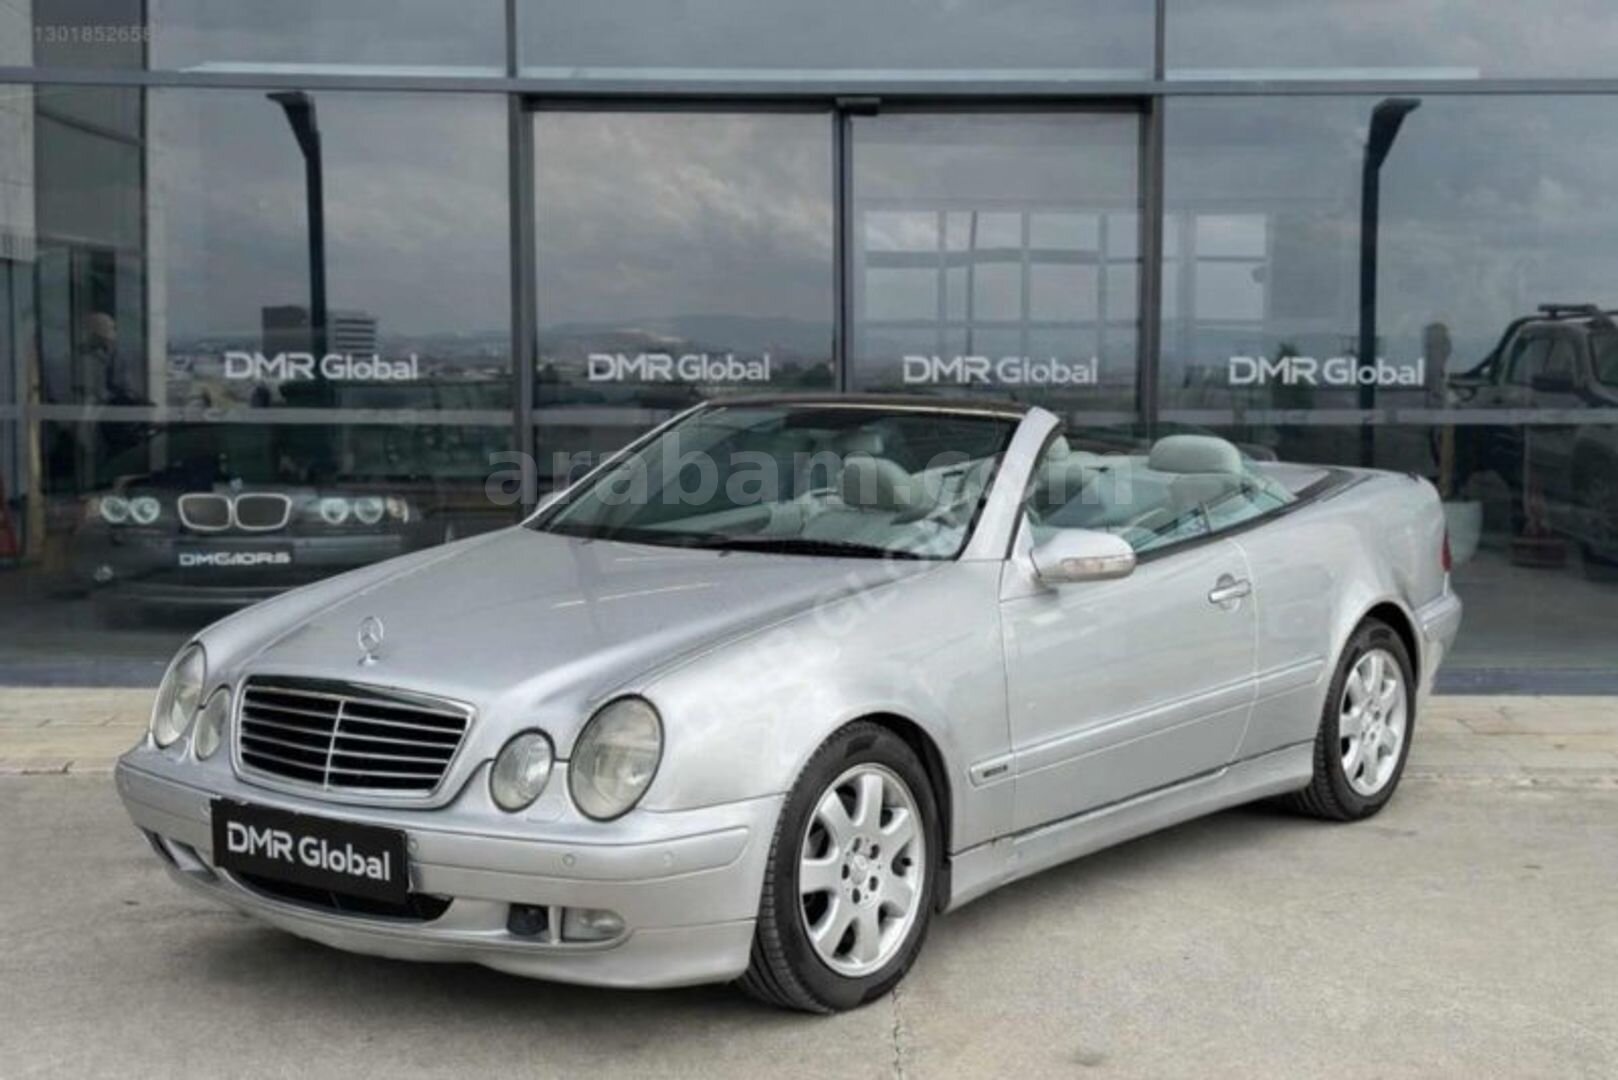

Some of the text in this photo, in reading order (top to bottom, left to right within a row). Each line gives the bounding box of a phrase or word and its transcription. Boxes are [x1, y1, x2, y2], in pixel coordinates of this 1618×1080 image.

[224, 352, 419, 380] DMR Global
[588, 353, 770, 381] DMR Global
[903, 355, 1098, 383] DMR Global
[1229, 356, 1425, 385] DMR Global
[226, 820, 391, 881] DMR Global
